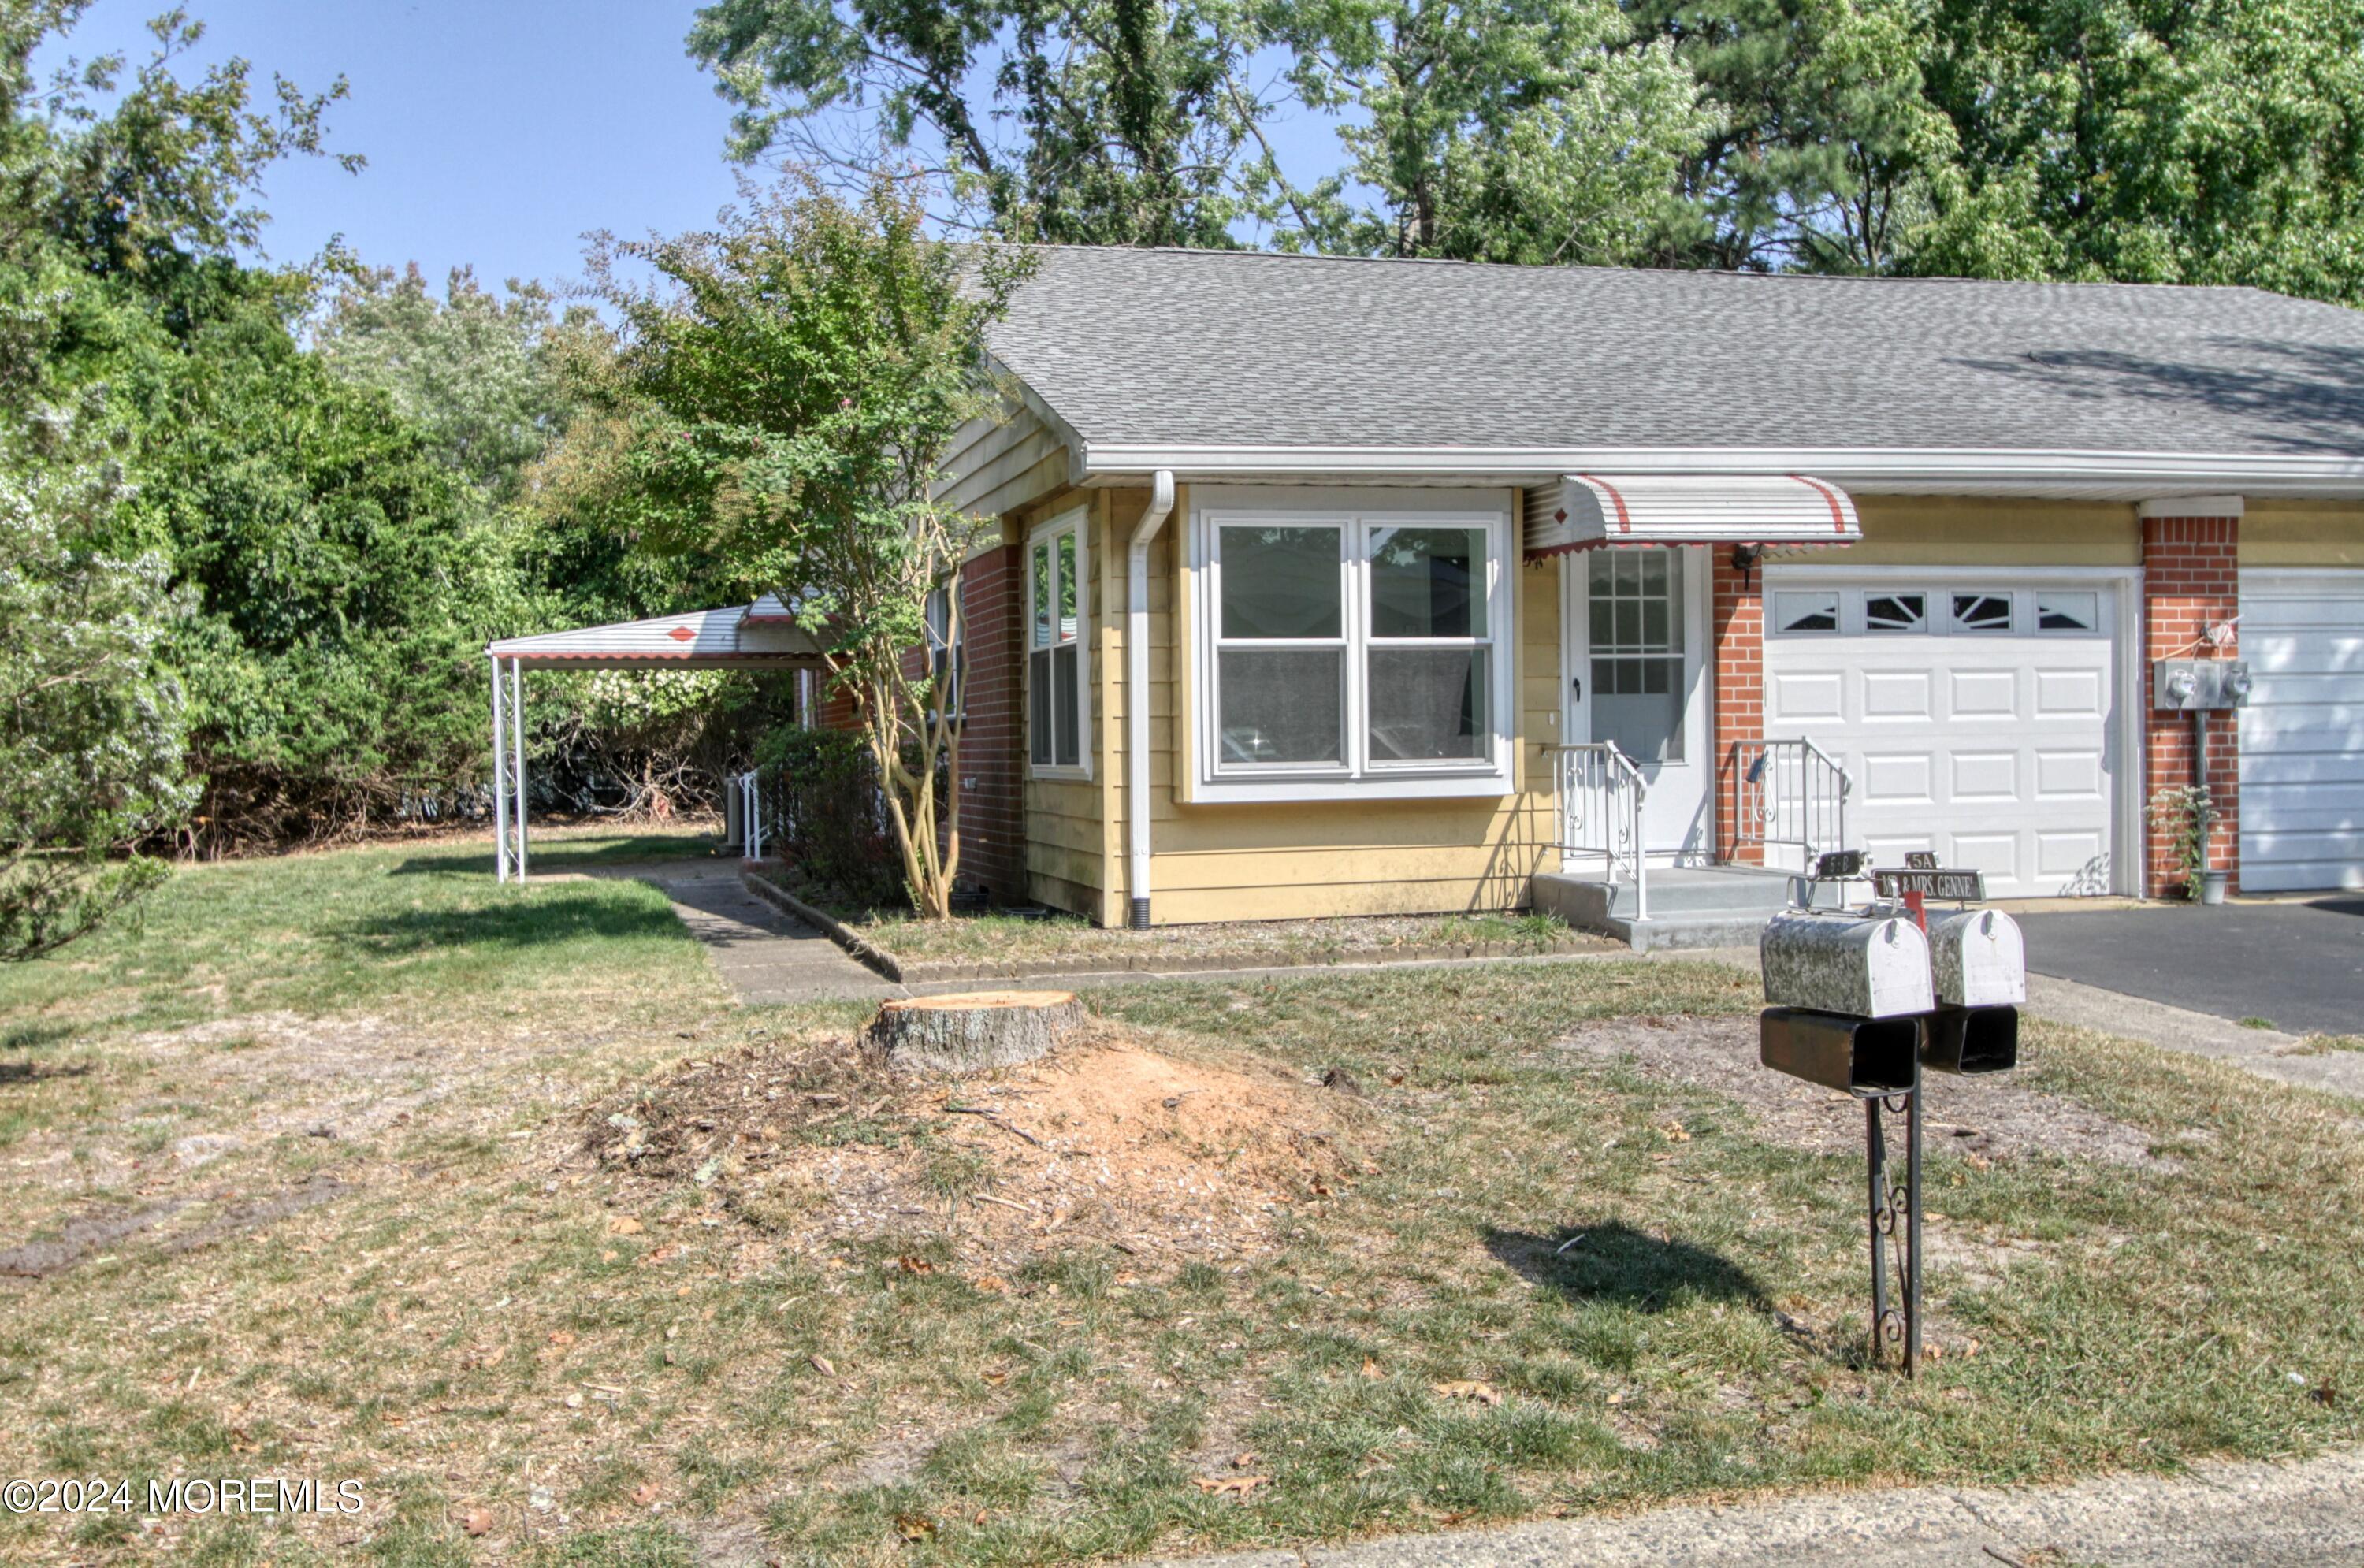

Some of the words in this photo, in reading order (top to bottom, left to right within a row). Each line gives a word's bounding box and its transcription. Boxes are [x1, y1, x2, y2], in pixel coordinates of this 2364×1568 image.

[1912, 854, 1933, 868] 5A
[1902, 876, 1910, 893] &
[1912, 875, 1936, 897] MRS.
